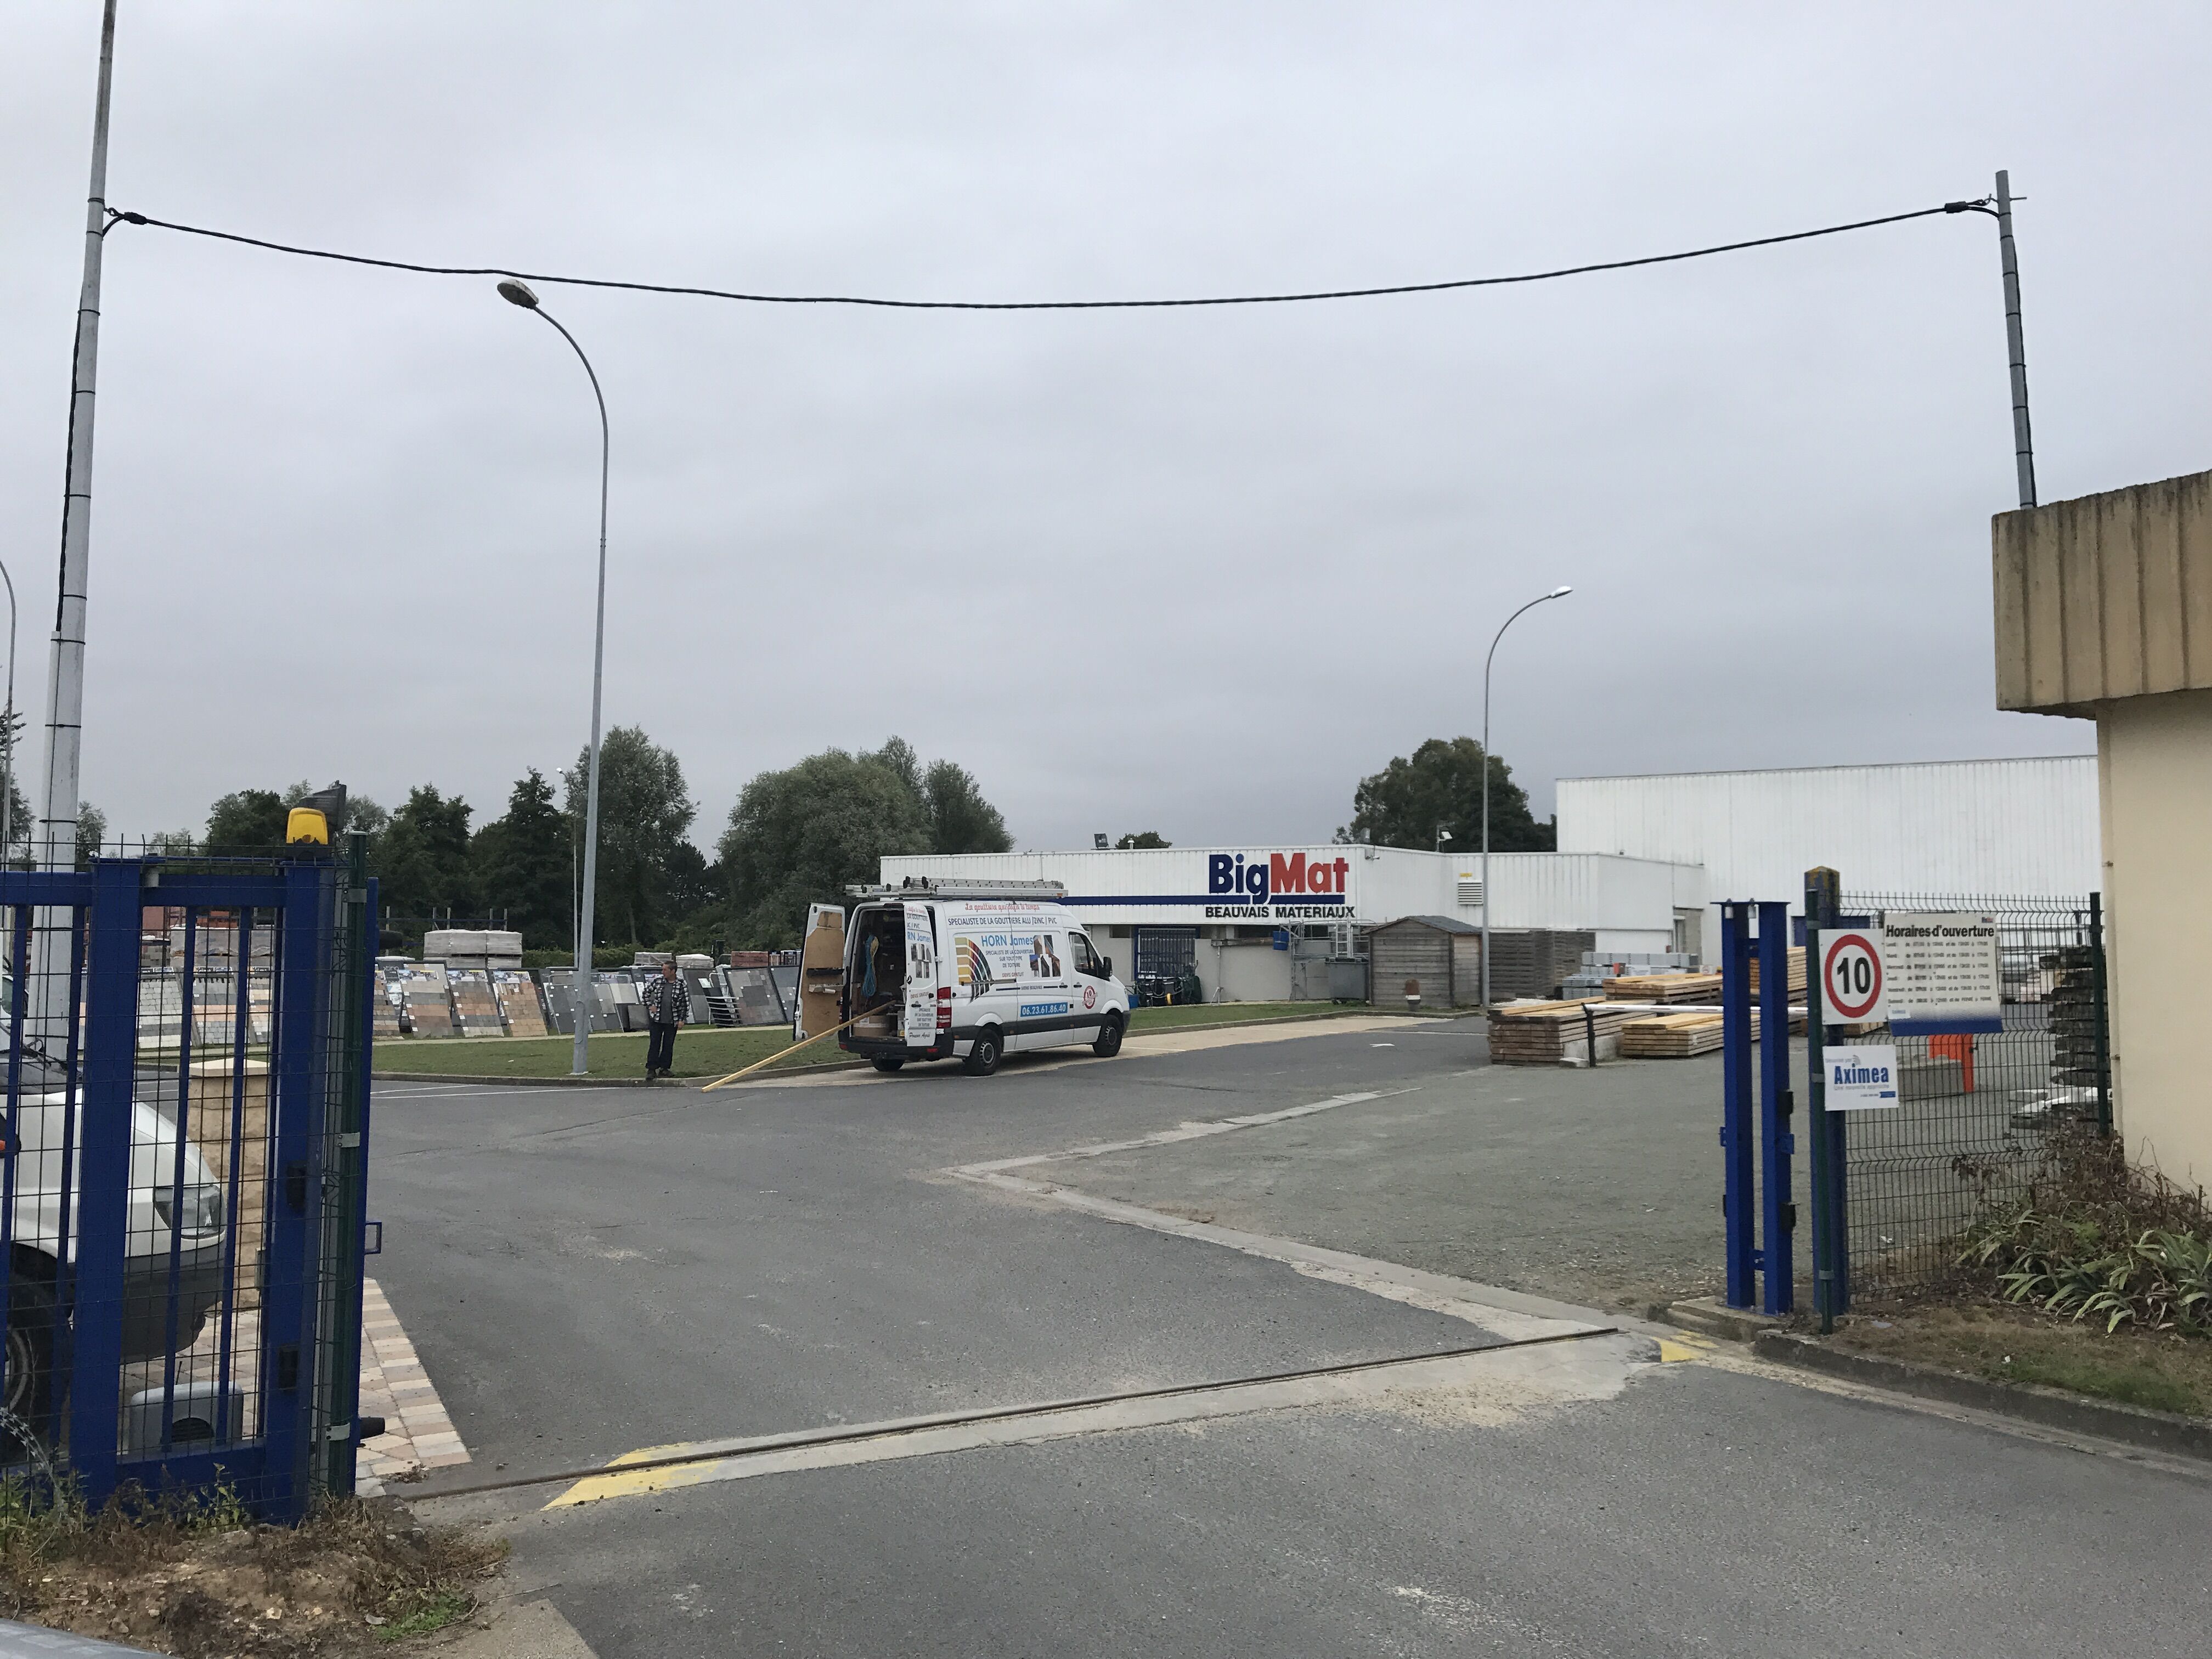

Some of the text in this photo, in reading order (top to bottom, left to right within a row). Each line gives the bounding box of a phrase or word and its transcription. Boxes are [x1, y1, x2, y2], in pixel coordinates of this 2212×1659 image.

[1209, 853, 1349, 904] BigMat
[1206, 906, 1355, 918] BEAUVAIS MATERIAUX
[948, 917, 979, 926] SPECIALISTE
[1886, 924, 1995, 938] Horaires d'ouverture
[981, 934, 1034, 946] HORN James
[1837, 957, 1871, 994] 10
[1022, 1004, 1066, 1015] 06.23.61.86.40
[1834, 1063, 1889, 1085] Aximea
